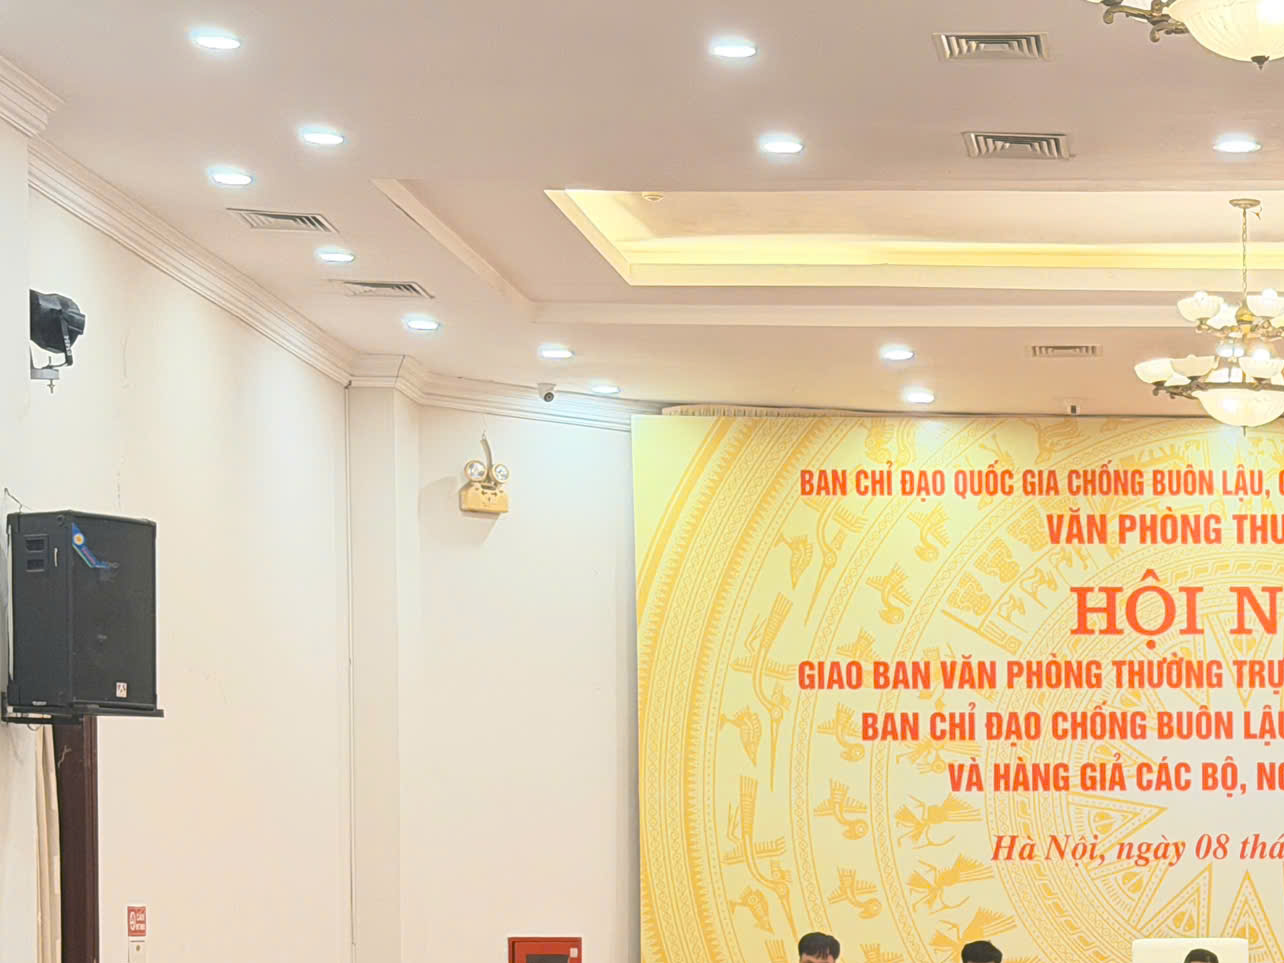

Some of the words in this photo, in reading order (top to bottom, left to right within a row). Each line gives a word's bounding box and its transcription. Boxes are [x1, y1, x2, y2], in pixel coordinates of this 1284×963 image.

[800, 469, 848, 497] BAN
[855, 460, 893, 497] CHỈ
[900, 470, 945, 502] ĐẠO
[954, 461, 1015, 499] QUỐC
[1022, 469, 1061, 497] GIA
[1067, 463, 1145, 497] CHỐNG
[1152, 464, 1214, 497] BUÔN
[1222, 465, 1271, 502] LẬU,
[1046, 507, 1108, 545] VĂN
[1118, 506, 1222, 545] PHÒNG
[1070, 568, 1205, 651] HỘI
[798, 660, 864, 690] GIAO
[873, 660, 931, 690] BAN
[940, 655, 997, 690] VĂN
[1007, 653, 1103, 689] PHÒNG
[1111, 652, 1223, 689] THƯỜNG
[861, 711, 920, 742] BAN
[929, 703, 977, 742] CHỈ
[985, 711, 1042, 748] ĐẠO
[1051, 700, 1147, 741] CHỐNG
[1157, 705, 1233, 740] BUÔN
[948, 757, 985, 793] VÀ
[993, 756, 1071, 793] HÀNG
[1079, 753, 1127, 792] GIẢ
[1135, 757, 1192, 792] CÁC
[1201, 756, 1247, 798] BỘ,
[992, 835, 1036, 861] Hà
[1045, 834, 1106, 867] Nội,
[1116, 836, 1186, 867] ngày
[1195, 835, 1230, 859] 08
